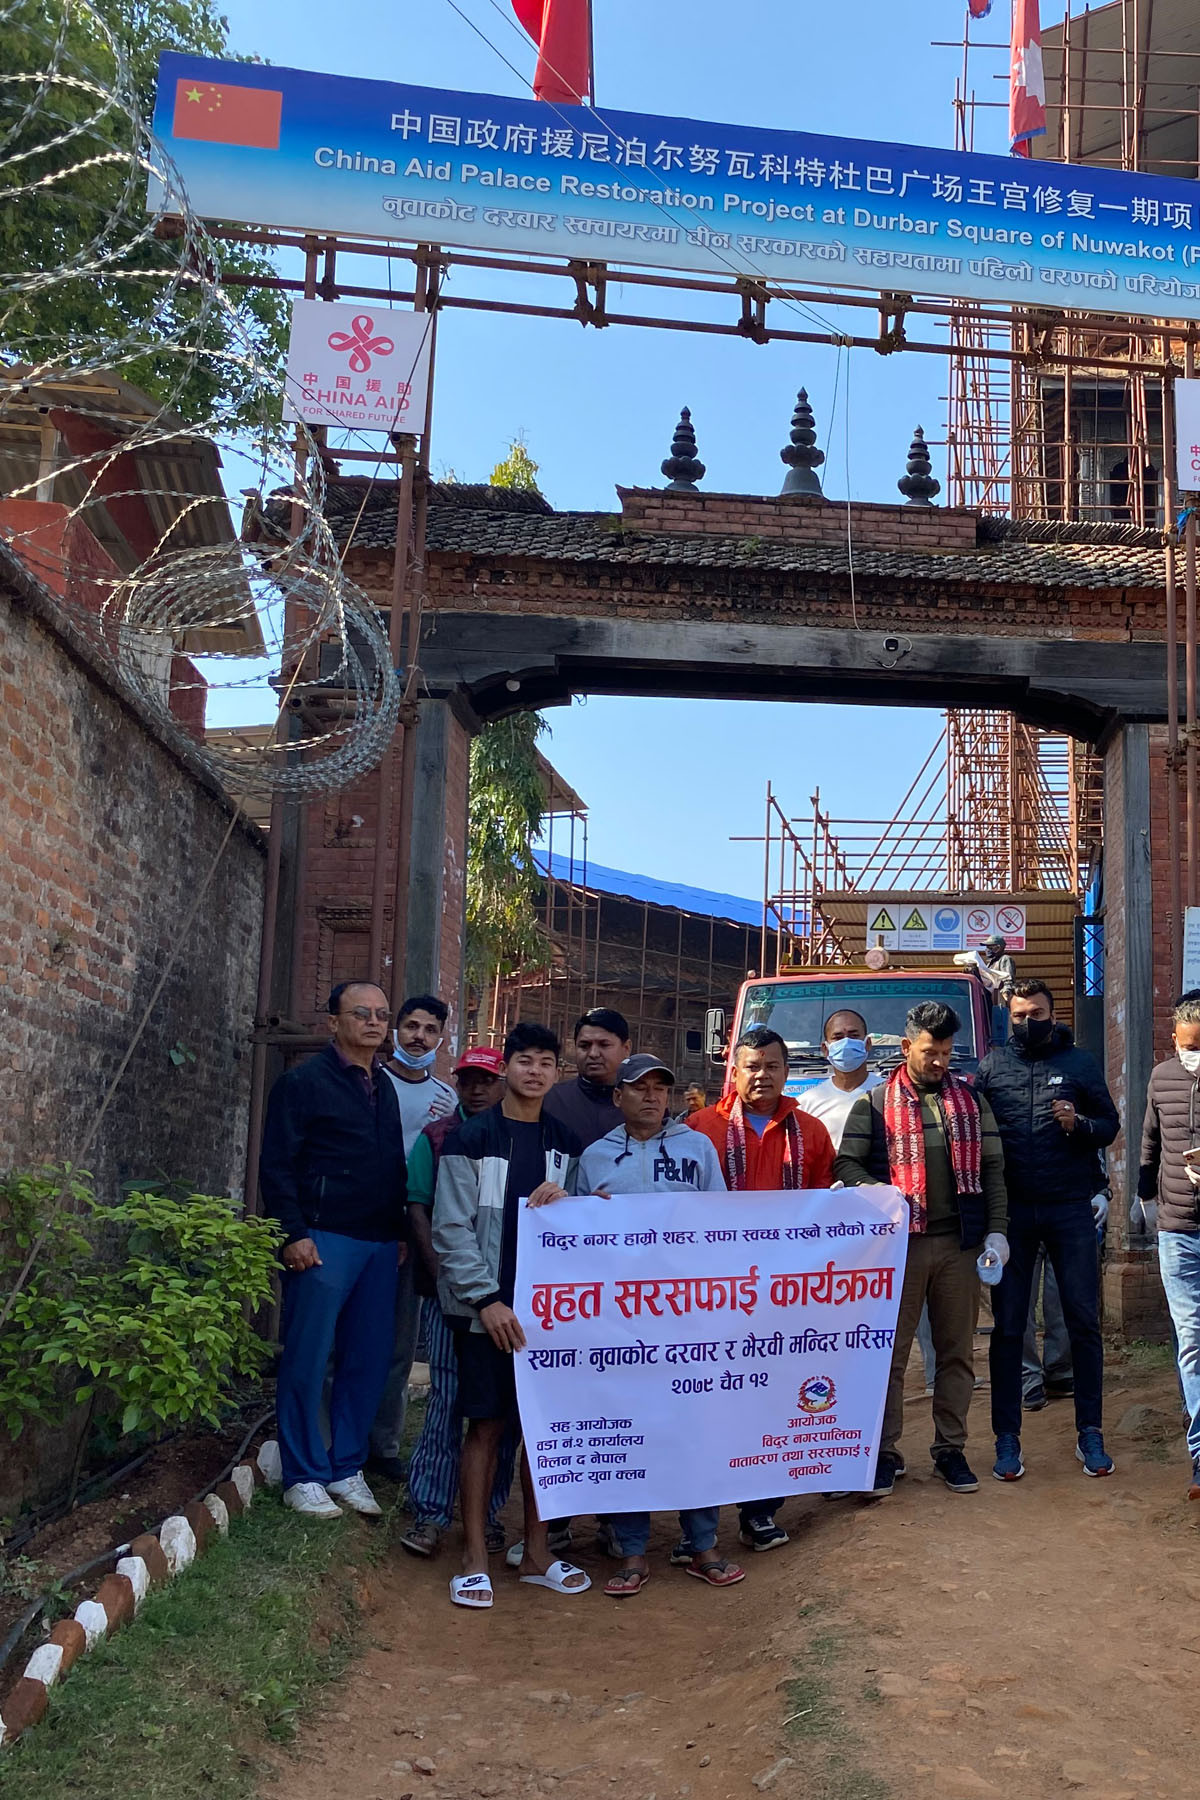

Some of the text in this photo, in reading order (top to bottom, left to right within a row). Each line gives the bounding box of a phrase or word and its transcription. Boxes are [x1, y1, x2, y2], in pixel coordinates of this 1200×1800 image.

[313, 146, 397, 175] China
[403, 157, 451, 181] Aid
[461, 163, 551, 192] Palace
[560, 174, 714, 211] Restoration
[723, 193, 815, 222] Project
[822, 206, 846, 225] at
[853, 207, 939, 236] Durbar
[947, 218, 1033, 245] Square
[1041, 231, 1065, 250] of
[1072, 232, 1175, 262] Nuwakot
[382, 195, 477, 223] नुवाकोट
[482, 206, 557, 232] दरबार
[684, 225, 732, 249] चीन
[736, 233, 847, 262] सरकारको
[853, 246, 962, 274] सहायतामा
[968, 256, 1034, 282] पहिलो
[1040, 267, 1118, 291] चरणको
[303, 372, 412, 395] 中国援助
[302, 388, 410, 411] CHINA AID
[303, 406, 406, 424] FOR SHARED FUTURE
[653, 1157, 698, 1184] F&M
[583, 1233, 620, 1246] नगर
[623, 1228, 658, 1247] हाम्रो
[703, 1229, 738, 1243] सफा
[742, 1228, 781, 1241] स्वच्छ
[785, 1223, 821, 1240] राख्ने
[531, 1261, 896, 1331] बृहत सरसफाई कार्यक्रम
[589, 1339, 660, 1372] नुवाकोट
[725, 1341, 737, 1360] र
[742, 1331, 785, 1358] भैरवी
[789, 1328, 840, 1353] मन्दिर
[845, 1323, 895, 1349] परिसर
[671, 1370, 769, 1394] २०७९ चैत १२
[787, 1414, 838, 1428] आयोजक
[536, 1440, 558, 1451] वडा
[588, 1433, 645, 1447] कार्यालय
[793, 1428, 862, 1444] नगरपालिका
[537, 1451, 627, 1470] क्लिन द नेपाल
[729, 1453, 778, 1468] वातावरण
[782, 1450, 803, 1462] तथा
[807, 1444, 860, 1460] सरसफाई
[538, 1469, 647, 1490] नुवाकोट युवा क्लब
[788, 1462, 832, 1480] नुवाकोट
